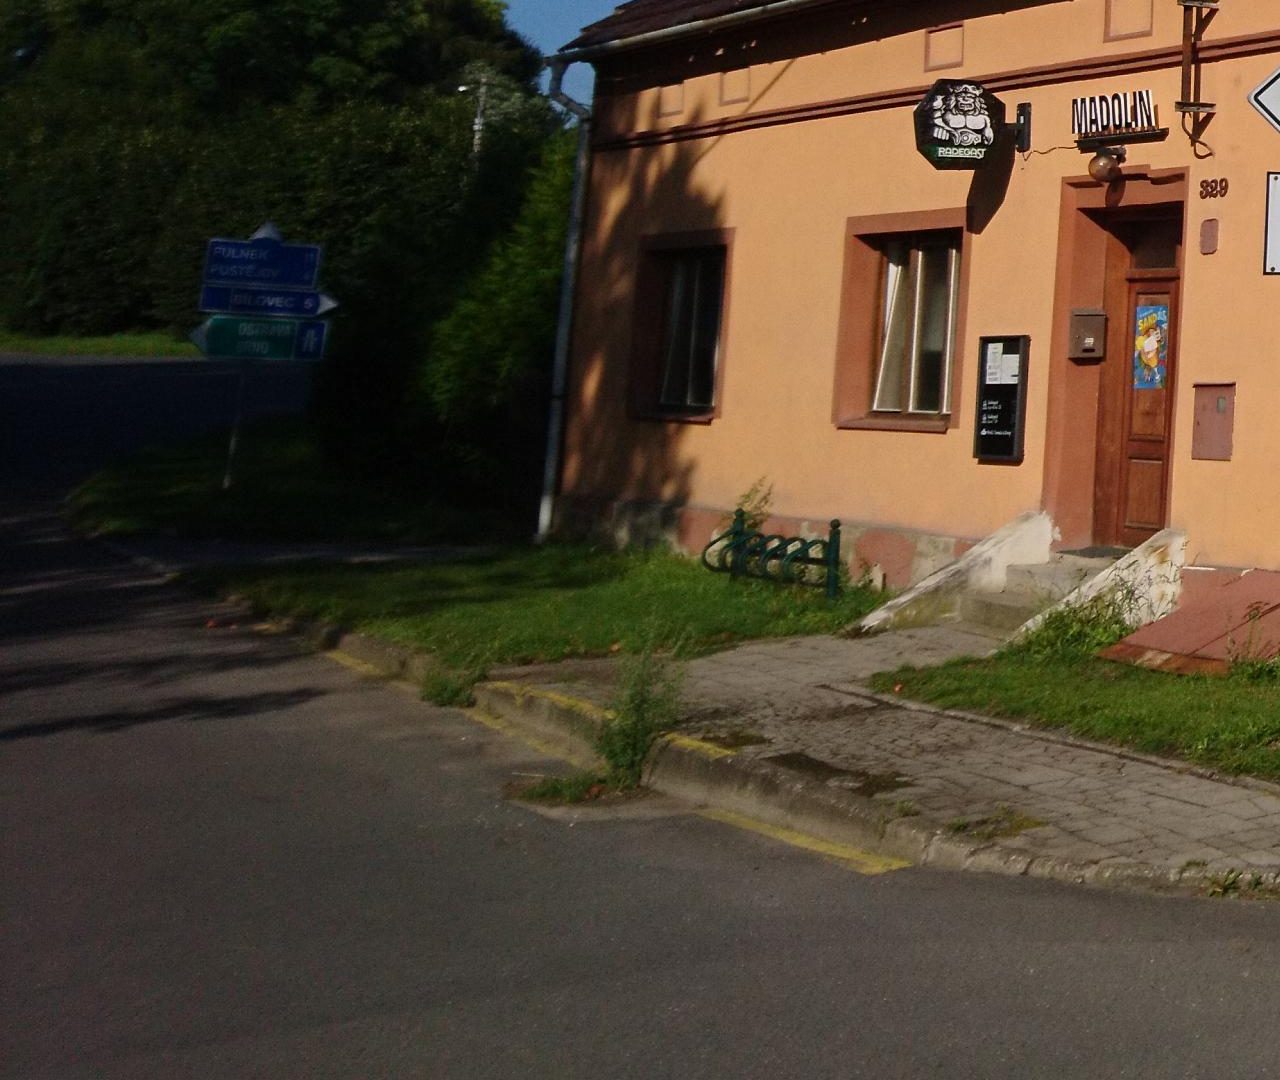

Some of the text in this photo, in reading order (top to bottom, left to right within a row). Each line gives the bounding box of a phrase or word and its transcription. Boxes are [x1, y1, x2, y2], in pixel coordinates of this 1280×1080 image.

[1072, 89, 1156, 135] MADOLIN
[937, 146, 987, 159] RADEGAST
[1200, 177, 1229, 200] 329
